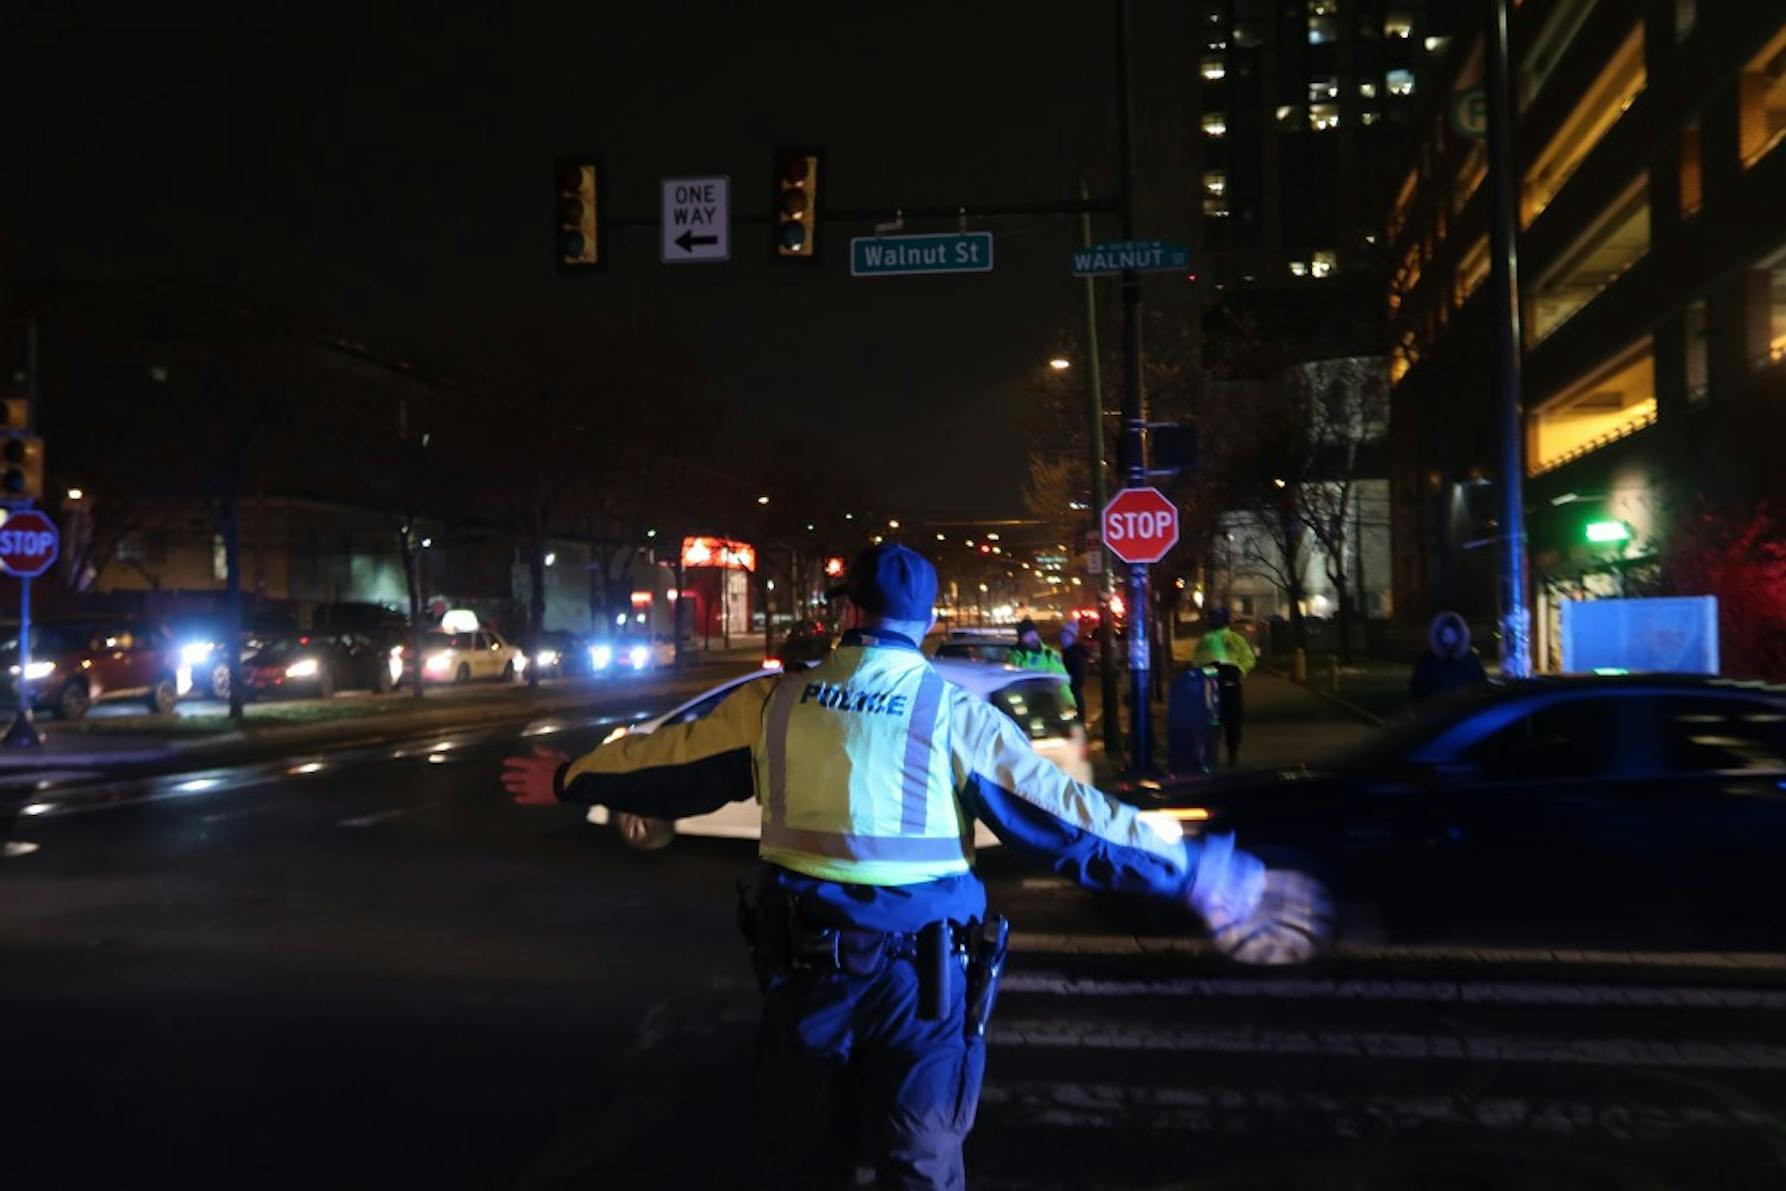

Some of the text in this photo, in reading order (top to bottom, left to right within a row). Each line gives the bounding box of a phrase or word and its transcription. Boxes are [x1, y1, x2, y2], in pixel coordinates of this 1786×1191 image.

[675, 185, 715, 204] ONE
[673, 206, 717, 225] WAY
[864, 241, 979, 267] Walnut St
[1074, 248, 1164, 271] WALNUT
[1109, 511, 1172, 540] STOP
[0, 529, 54, 556] STOP
